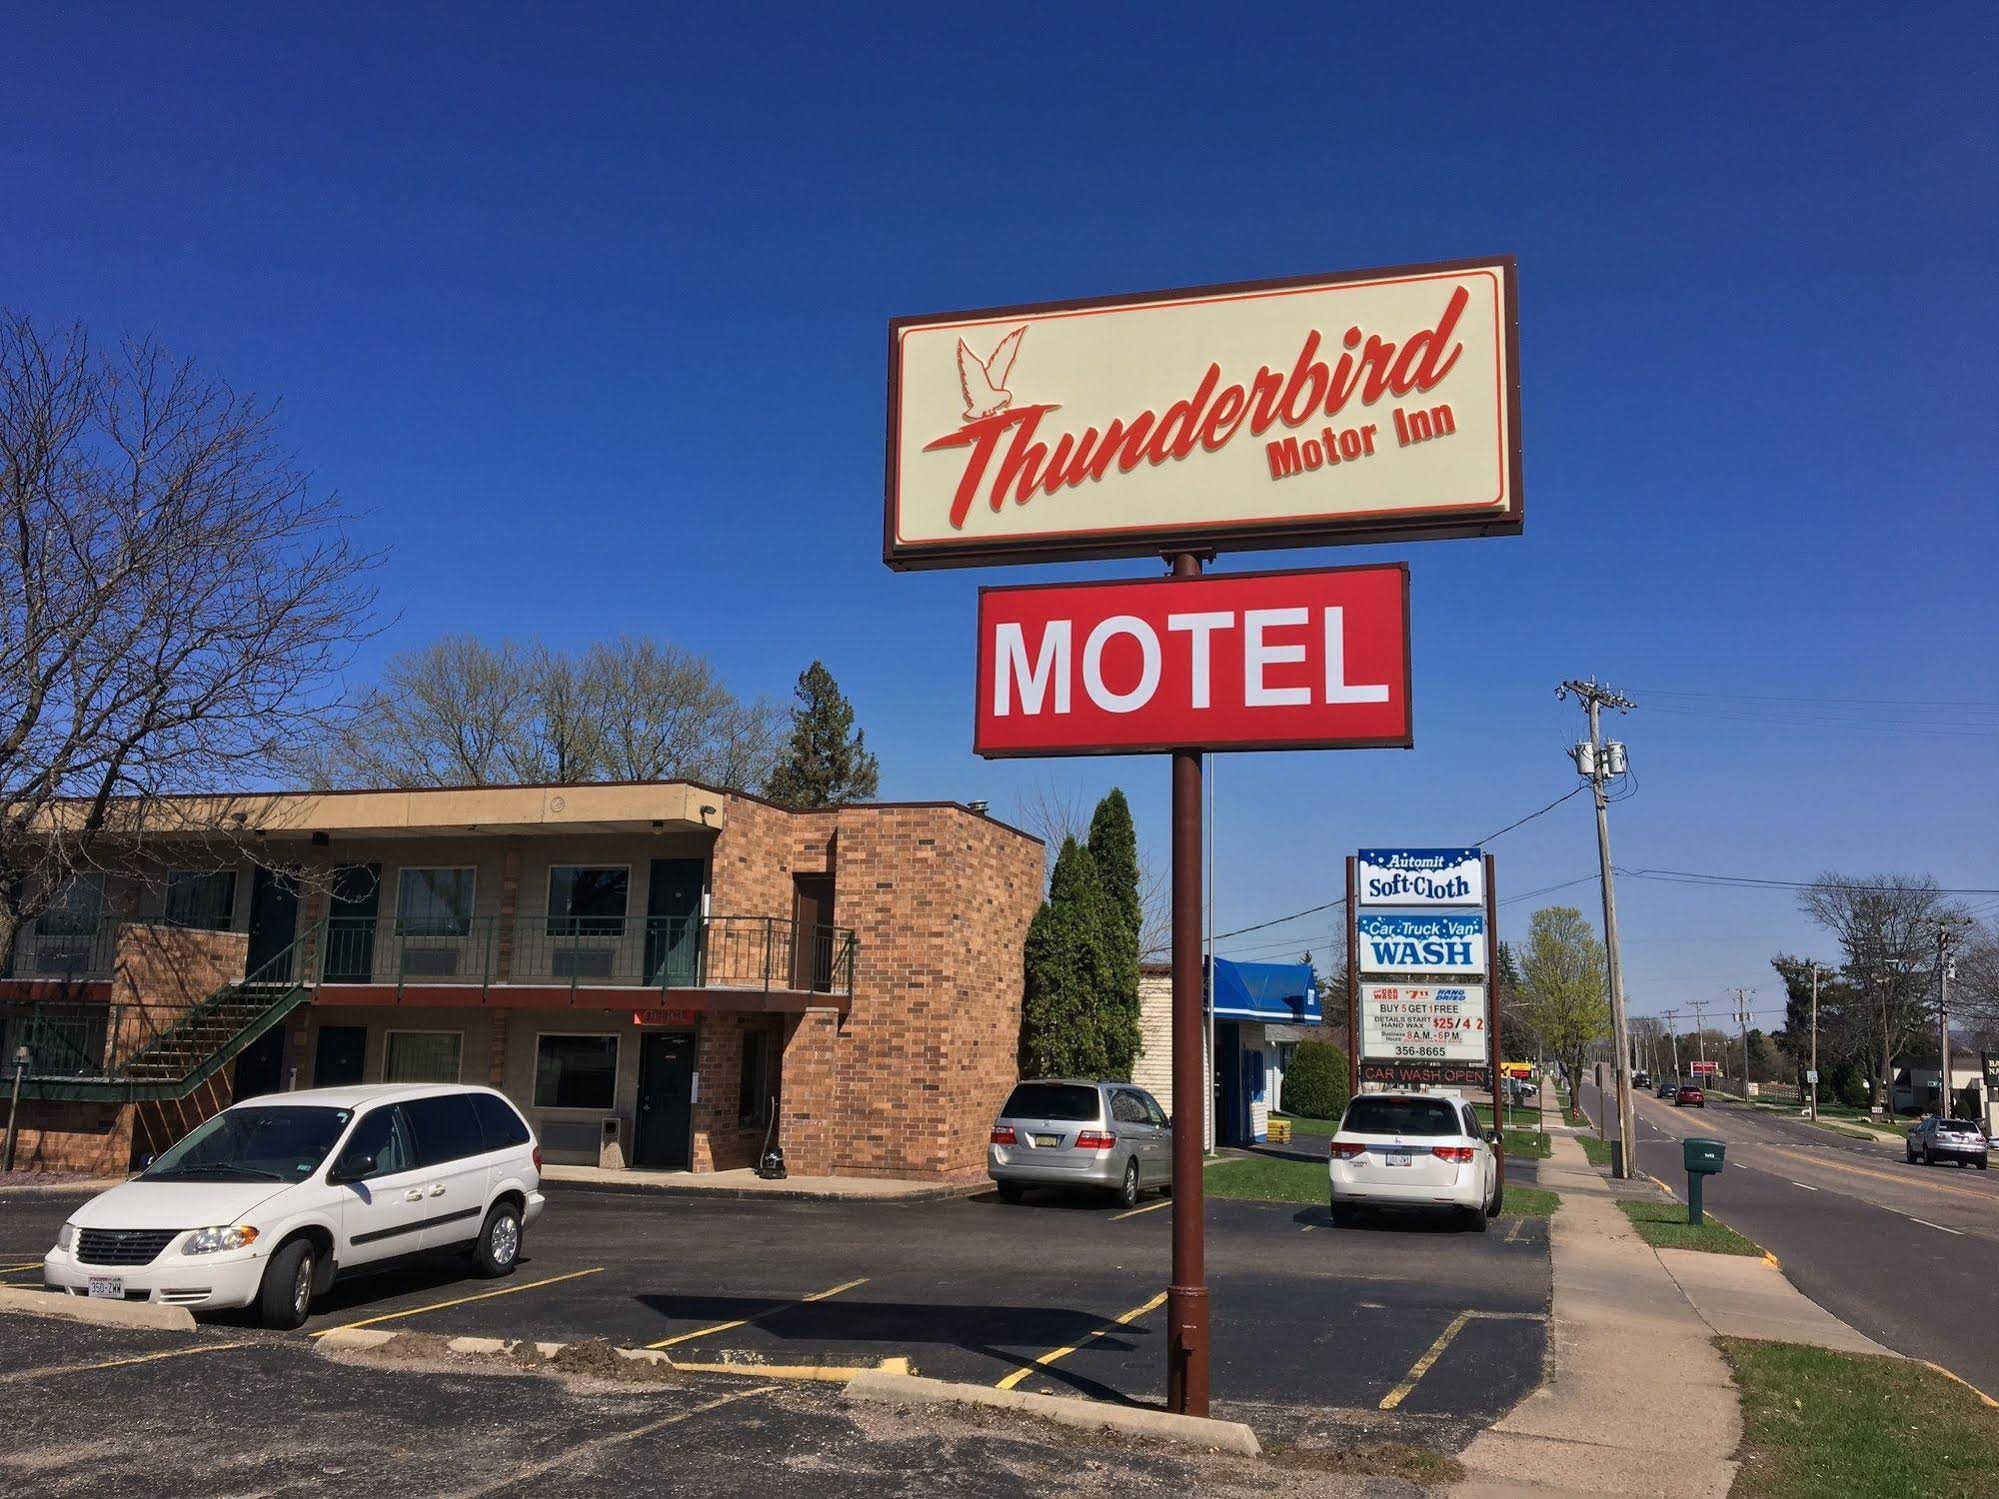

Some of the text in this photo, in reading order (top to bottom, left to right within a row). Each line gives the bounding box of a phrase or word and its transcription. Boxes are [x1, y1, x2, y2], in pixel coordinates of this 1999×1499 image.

[922, 285, 1470, 530] Thunderbird
[1266, 404, 1456, 481] Motor Inn
[994, 606, 1389, 716] MOTEL
[1387, 855, 1444, 868] Automit
[1369, 922, 1474, 935] Car Truck Van
[1370, 942, 1473, 965] WASH
[1380, 1004, 1399, 1014] BUY
[1401, 1004, 1407, 1013] 5
[1408, 1004, 1427, 1014] GET
[1434, 1005, 1459, 1014] FREE
[1395, 1046, 1446, 1057] 356-8665
[1364, 1067, 1484, 1082] CAR WASH OPEN
